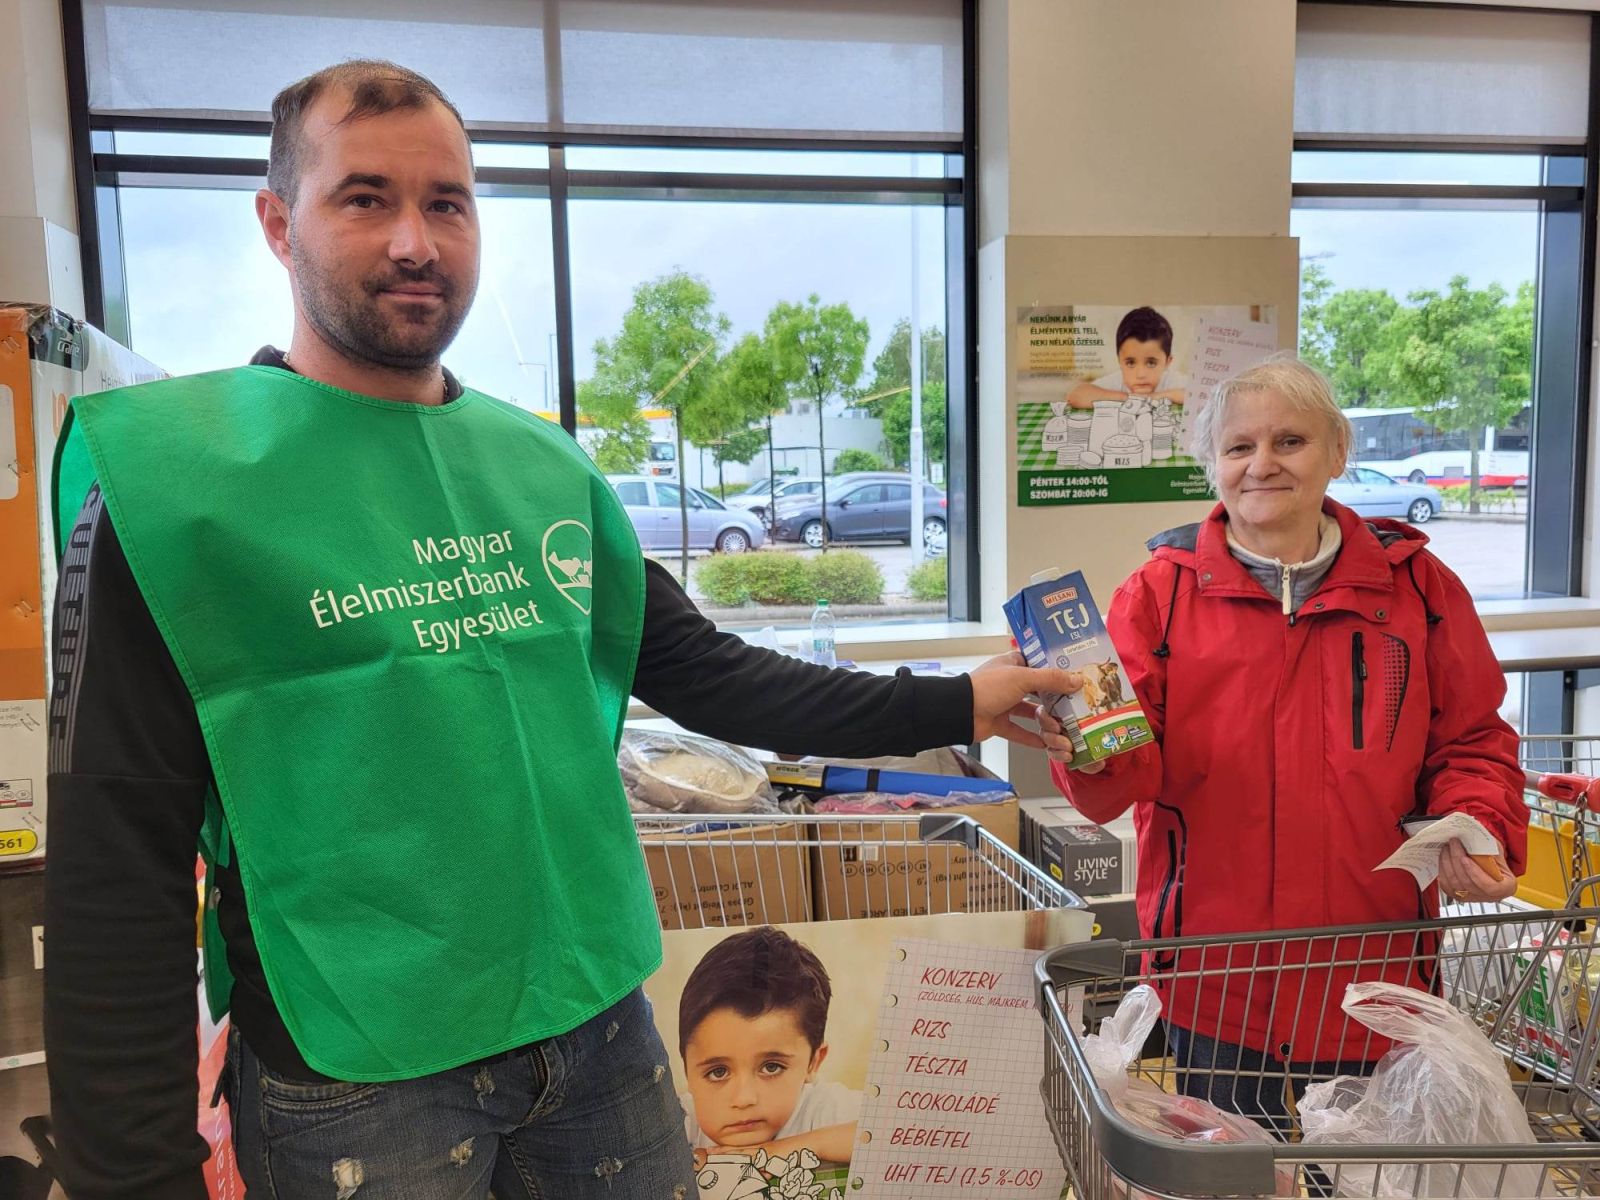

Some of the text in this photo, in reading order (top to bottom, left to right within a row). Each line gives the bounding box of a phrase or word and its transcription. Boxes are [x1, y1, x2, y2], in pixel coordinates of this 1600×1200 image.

[1068, 314, 1087, 323] NYÁR
[1030, 327, 1081, 335] ÉLMÉNYEKKEL
[1029, 474, 1109, 487] PÉNTEK 14:00-TÓL
[1029, 487, 1109, 500] SZOMBAT 20:00-IG
[412, 530, 513, 565] Magyar
[309, 561, 532, 629] Élelmiszerbank
[1045, 591, 1075, 605] MILSANI
[412, 600, 544, 654] Egyesület
[1046, 603, 1090, 634] TEJ
[1077, 856, 1118, 870] LIVING
[1074, 867, 1108, 886] STYLE
[920, 967, 1003, 991] KONZERV
[911, 1018, 952, 1039] RIZS
[905, 1052, 968, 1076] TÉSZTA
[897, 1091, 1001, 1114] CSOKOLÁDÉ
[890, 1124, 971, 1148] BÉBIÉTEL
[884, 1163, 923, 1183] UHT
[925, 1166, 957, 1187] TEJ
[995, 1168, 1043, 1190] %-OS)
